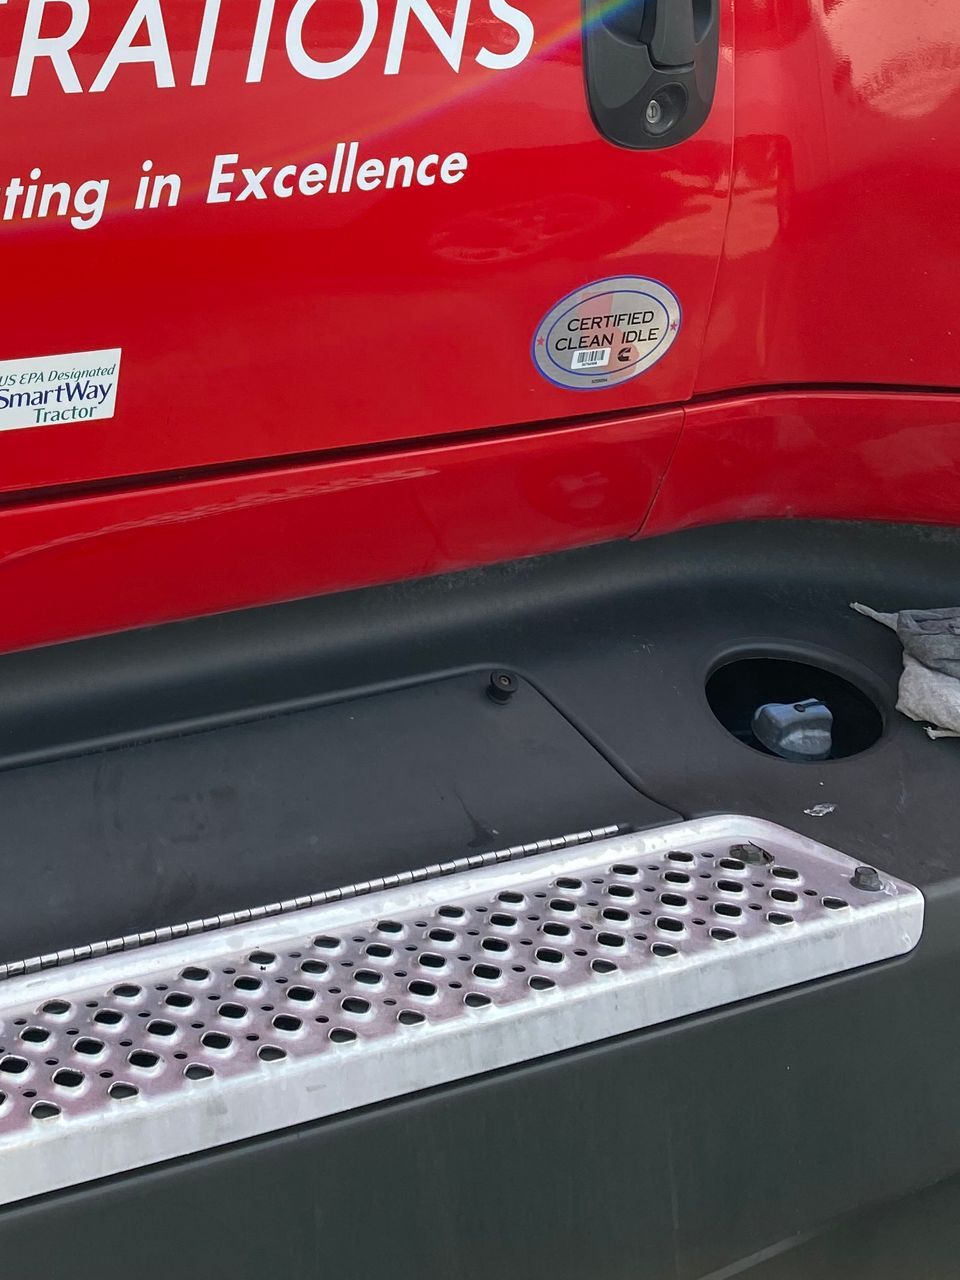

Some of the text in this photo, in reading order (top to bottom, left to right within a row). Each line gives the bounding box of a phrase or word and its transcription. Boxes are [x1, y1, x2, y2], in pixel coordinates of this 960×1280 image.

[135, 160, 181, 210] in
[207, 142, 468, 204] Excellence
[567, 310, 655, 332] CERTIFIED
[555, 327, 660, 351] CLEAN IDLE
[19, 372, 44, 384] EPA
[48, 363, 117, 383] Designated
[33, 405, 98, 424] Tractor
